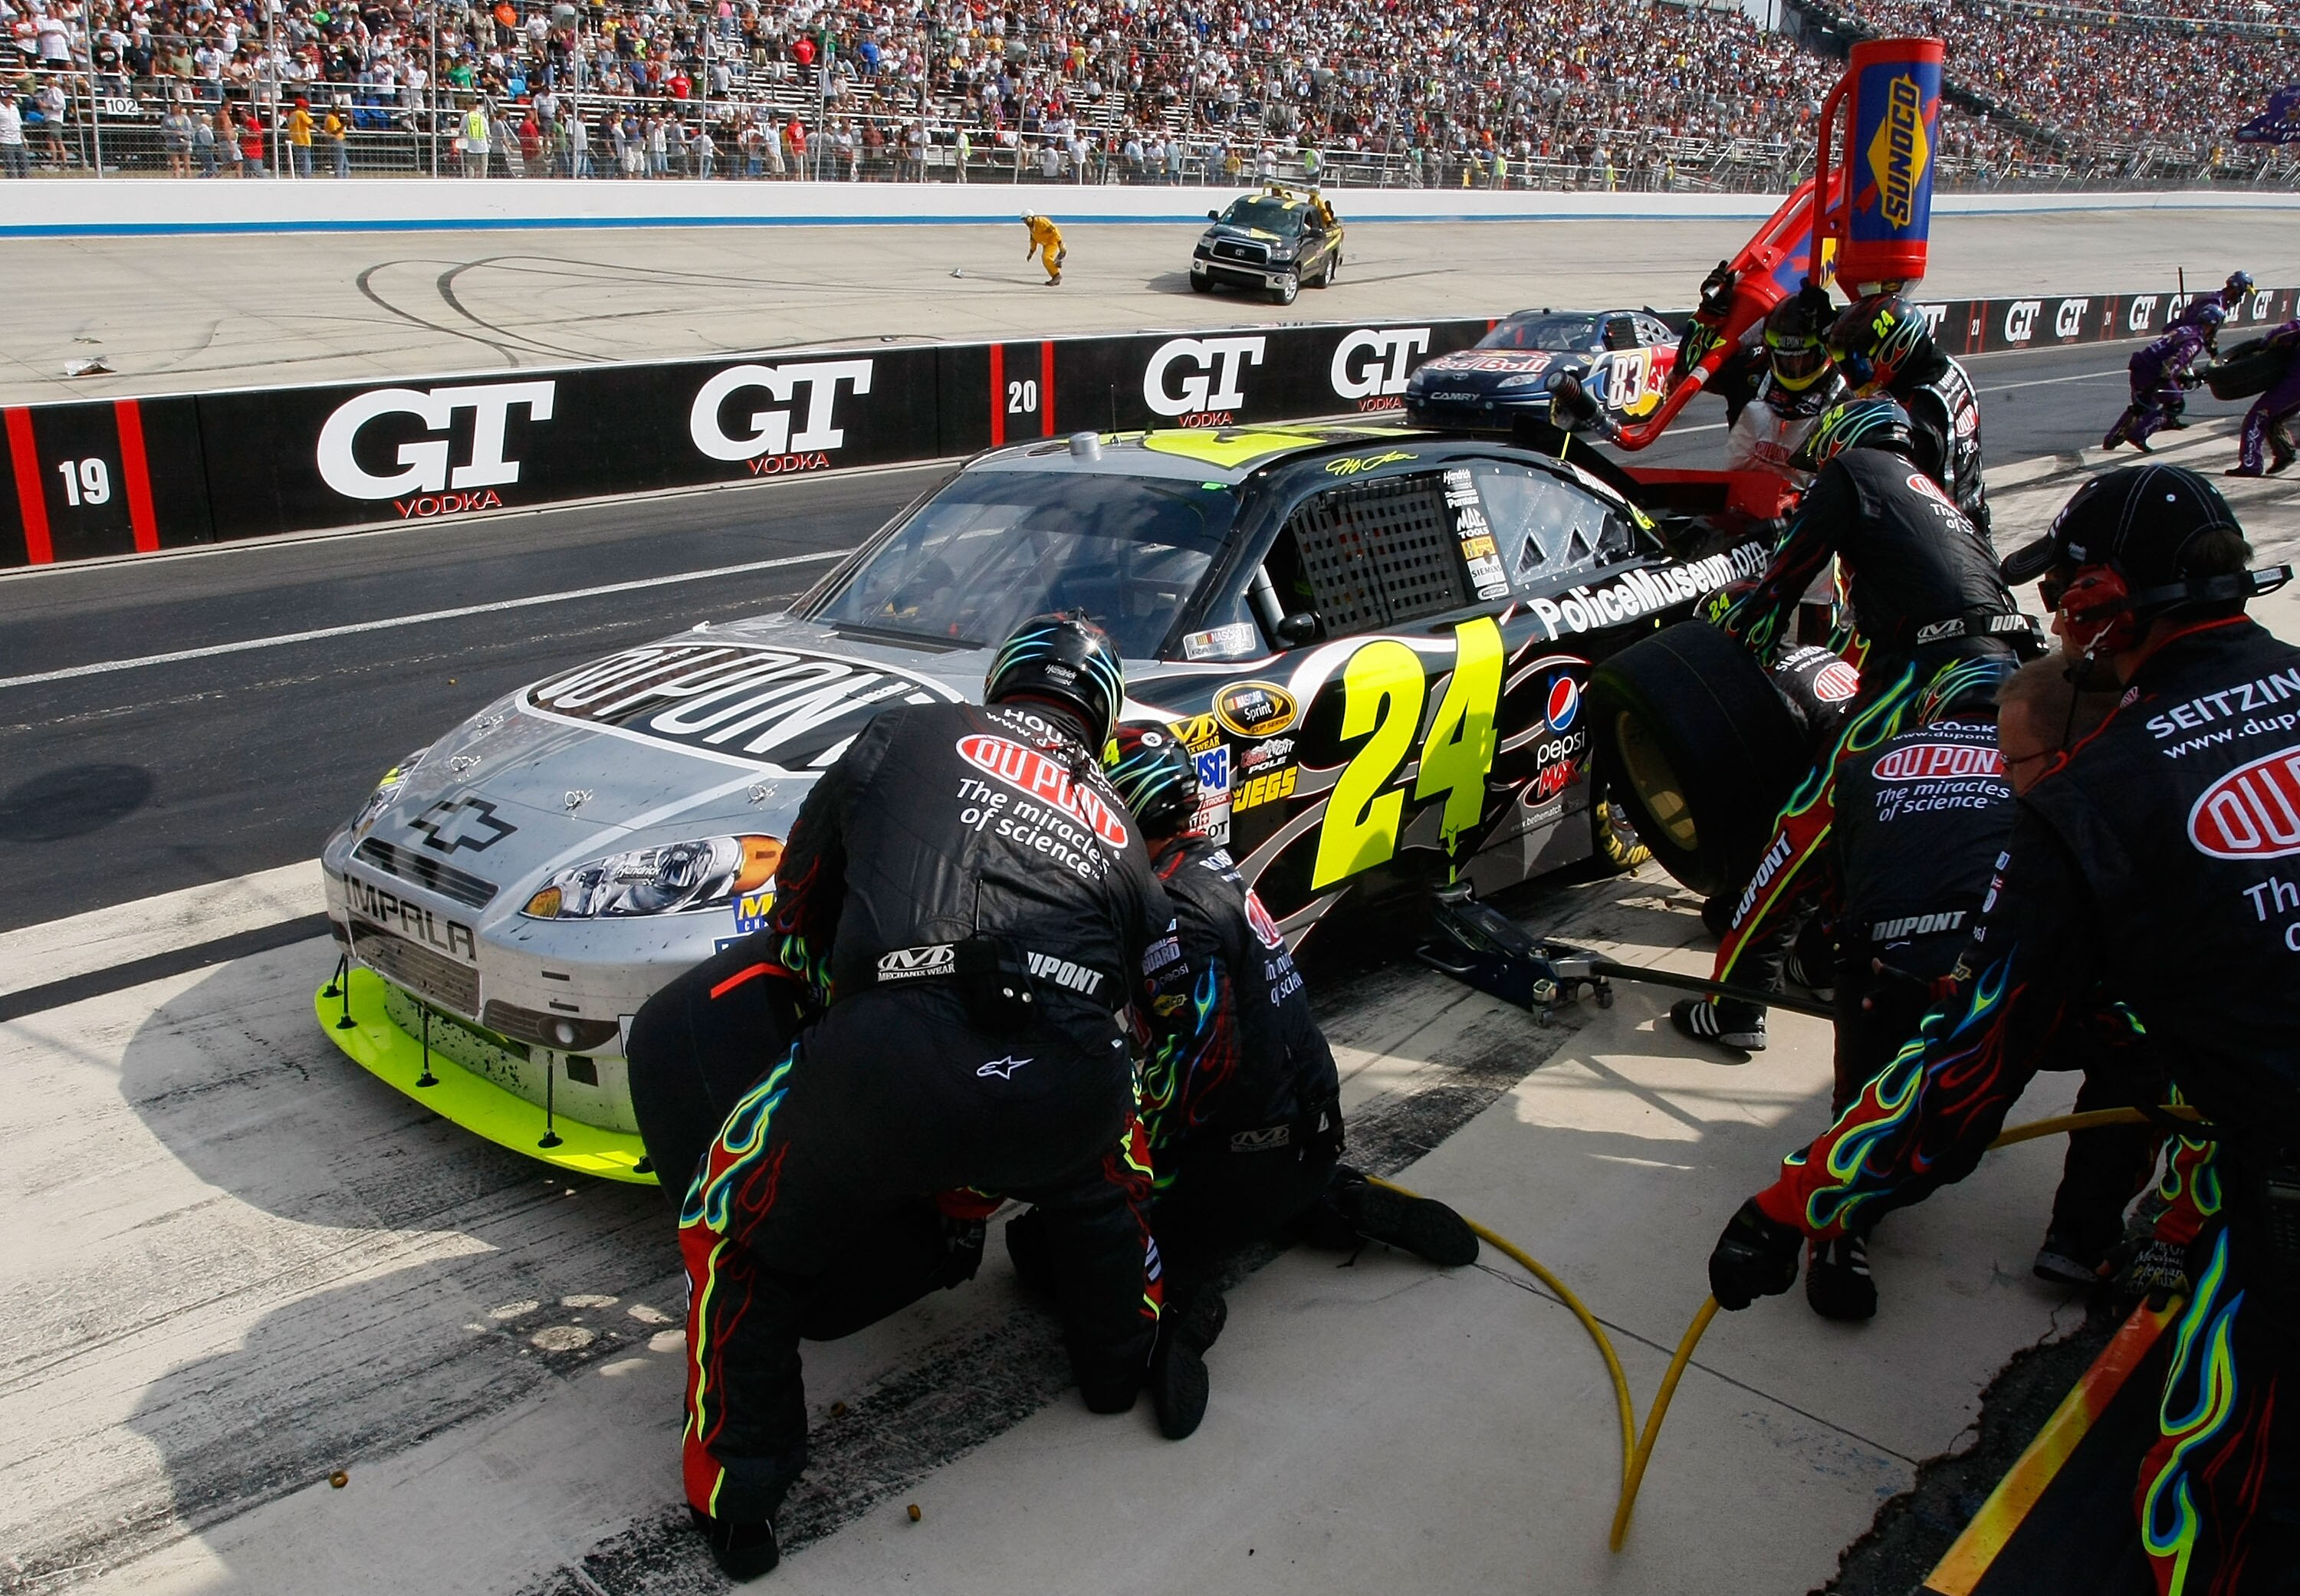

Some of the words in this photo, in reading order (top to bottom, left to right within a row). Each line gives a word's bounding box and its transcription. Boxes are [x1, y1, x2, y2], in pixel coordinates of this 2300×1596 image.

[107, 99, 137, 113] 102
[1886, 81, 1917, 221] SUNOCO
[1872, 310, 1895, 338] 24
[1971, 319, 1980, 336] 23
[2004, 301, 2042, 342] GT
[2056, 299, 2088, 337] GT
[2129, 296, 2157, 332] GT
[1143, 336, 1266, 416] GT
[1330, 328, 1431, 399] GT
[1473, 357, 1552, 373] Bull
[1608, 354, 1644, 410] 83
[1008, 380, 1037, 413] 20
[1358, 396, 1401, 412] VODKA
[1431, 392, 1480, 400] CAMRY
[690, 359, 873, 461] GT
[1178, 412, 1233, 428] VODKA
[317, 381, 556, 500] GT
[748, 452, 829, 476] VODKA
[58, 458, 110, 506] 19
[393, 489, 502, 519] VODKA
[1457, 507, 1487, 531] MAC
[1458, 527, 1489, 539] TOOLS
[1471, 565, 1502, 578] SIEMENS
[1527, 541, 1768, 642] PoliceMuseum.org
[1708, 593, 1731, 623] 24
[1044, 664, 1077, 680] Hendrick
[1237, 690, 1263, 708] NASCAR
[1244, 701, 1272, 721] Sprint
[1252, 723, 1266, 733] CUP
[1267, 717, 1290, 728] SERIES
[1928, 721, 1997, 733] COOK
[1196, 735, 1221, 753] WEAR
[1311, 616, 1505, 891] 24
[1537, 726, 1585, 770] pepsi
[1248, 757, 1287, 774] POLE
[1537, 755, 1582, 798] MAX
[1232, 766, 1298, 813] JEGS
[1876, 787, 1909, 807] The
[1913, 780, 2011, 799] miracles
[959, 806, 997, 832] of
[1879, 800, 1904, 822] of
[957, 778, 1007, 807] The
[1012, 800, 1110, 875] miracles
[616, 865, 662, 878] Hendrick
[343, 873, 477, 961] IMPALA
[1872, 911, 1967, 941] DUPONT
[878, 970, 926, 982] MECHANIX
[927, 963, 955, 977] WEAR
[1142, 943, 1181, 976] GUARD
[1158, 964, 1189, 987] pepsi
